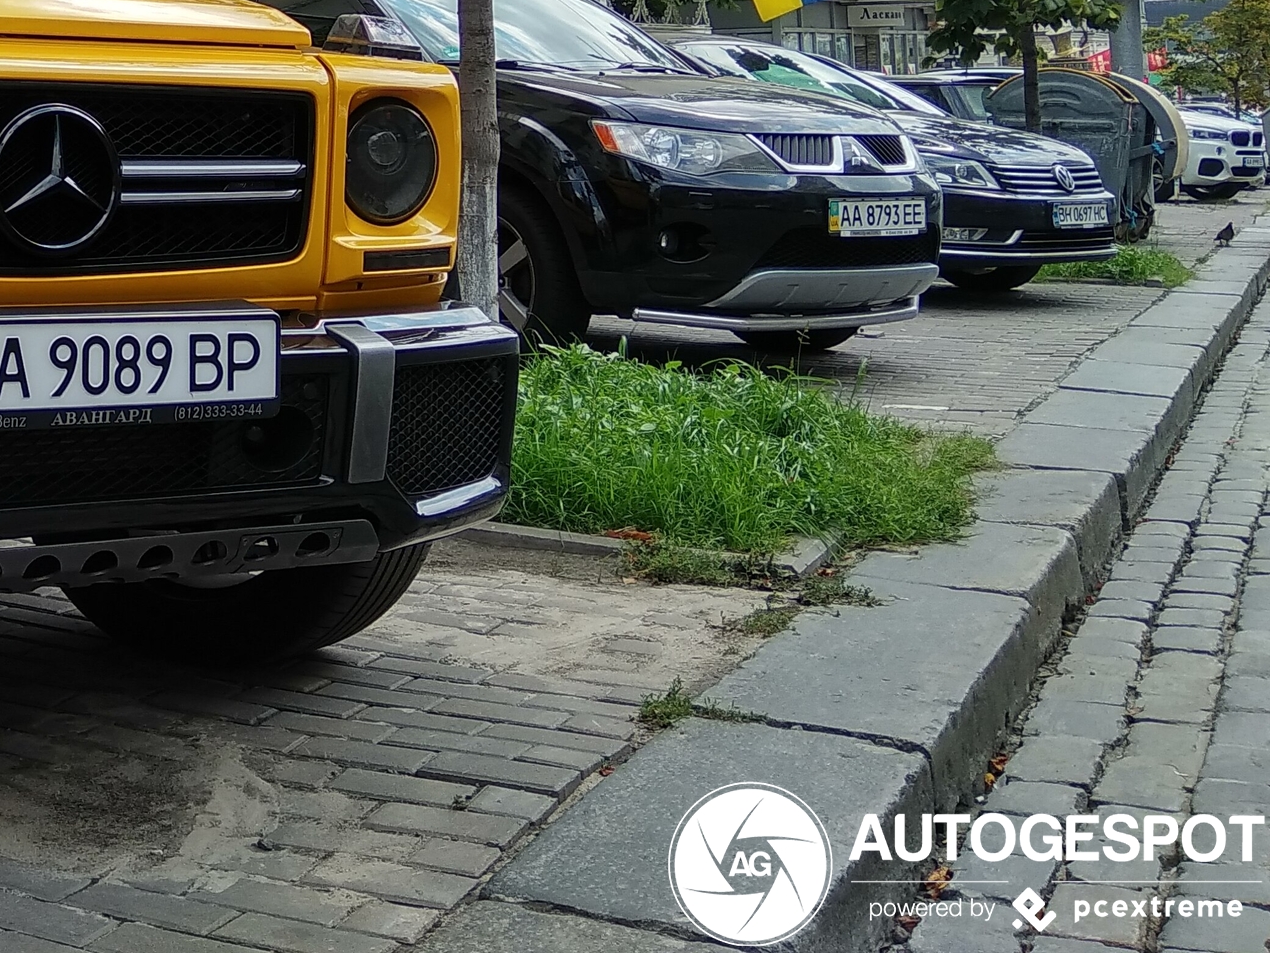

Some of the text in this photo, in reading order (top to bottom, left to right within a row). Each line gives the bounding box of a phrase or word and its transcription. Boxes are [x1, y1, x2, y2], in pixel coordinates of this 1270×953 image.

[840, 204, 923, 227] AA 8793 EE
[1058, 206, 1106, 222] BH 0697 HC
[49, 334, 173, 397] 9089
[189, 332, 261, 393] BP
[50, 408, 152, 426] АВАНГАРД
[174, 403, 263, 422] (812)333-33-44
